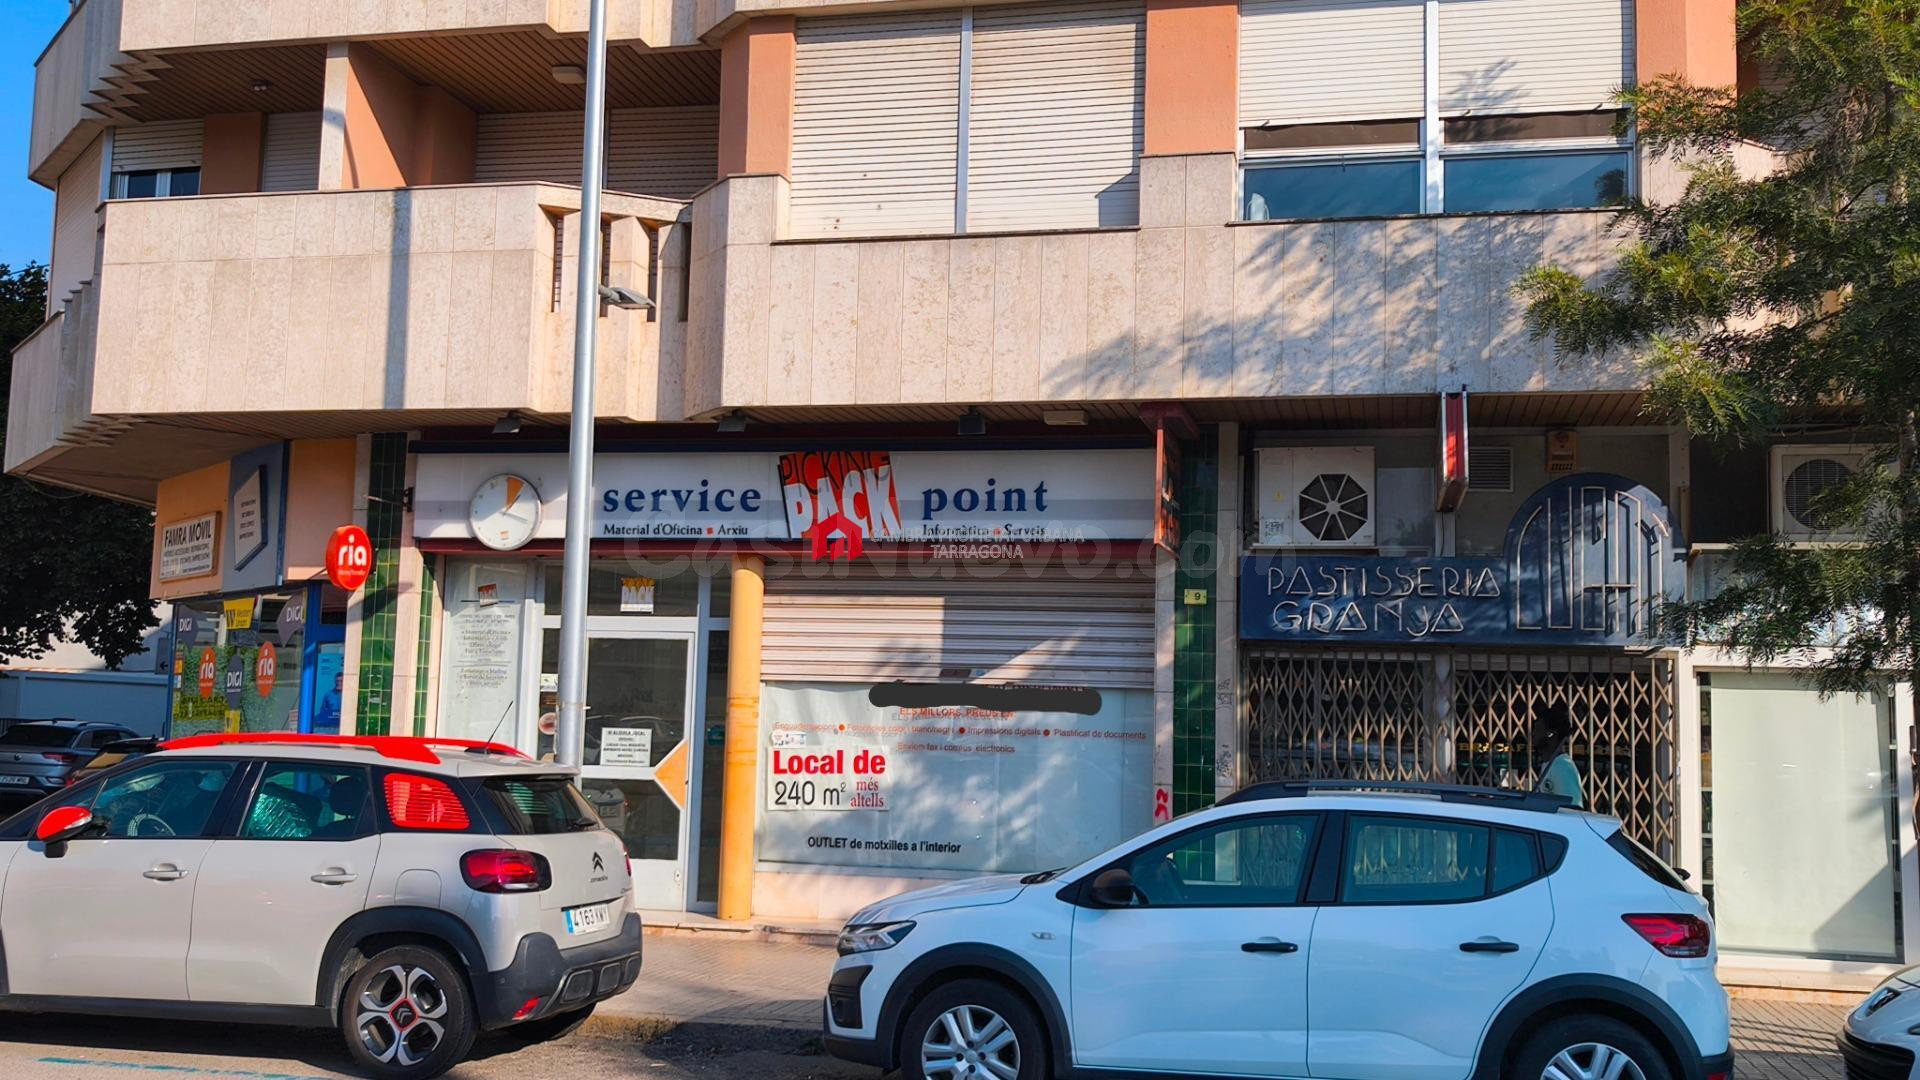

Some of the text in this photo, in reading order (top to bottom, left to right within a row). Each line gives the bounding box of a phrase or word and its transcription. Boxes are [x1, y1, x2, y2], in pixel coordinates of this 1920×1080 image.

[603, 479, 761, 513] service
[783, 465, 902, 539] PACK
[922, 478, 1048, 520] point
[188, 519, 212, 543] MOVIL
[603, 523, 748, 536] Material d'Oficina Arxiu
[1004, 523, 1046, 537] Serveis
[338, 534, 367, 566] ria
[1268, 566, 1500, 598] PASTISSERIA
[1194, 592, 1201, 600] 9
[179, 618, 192, 632] DIGI
[1273, 600, 1464, 638] GRANJA
[200, 654, 214, 679] ria
[258, 649, 274, 675] ria
[227, 671, 242, 687] DIGI
[1104, 731, 1147, 740] documents
[773, 750, 886, 775] Local de
[774, 780, 815, 806] 240
[856, 778, 879, 792] més
[850, 793, 884, 808] altells
[807, 836, 961, 853] OUTLET de motxilles a l'interior
[574, 909, 594, 927] 4163
